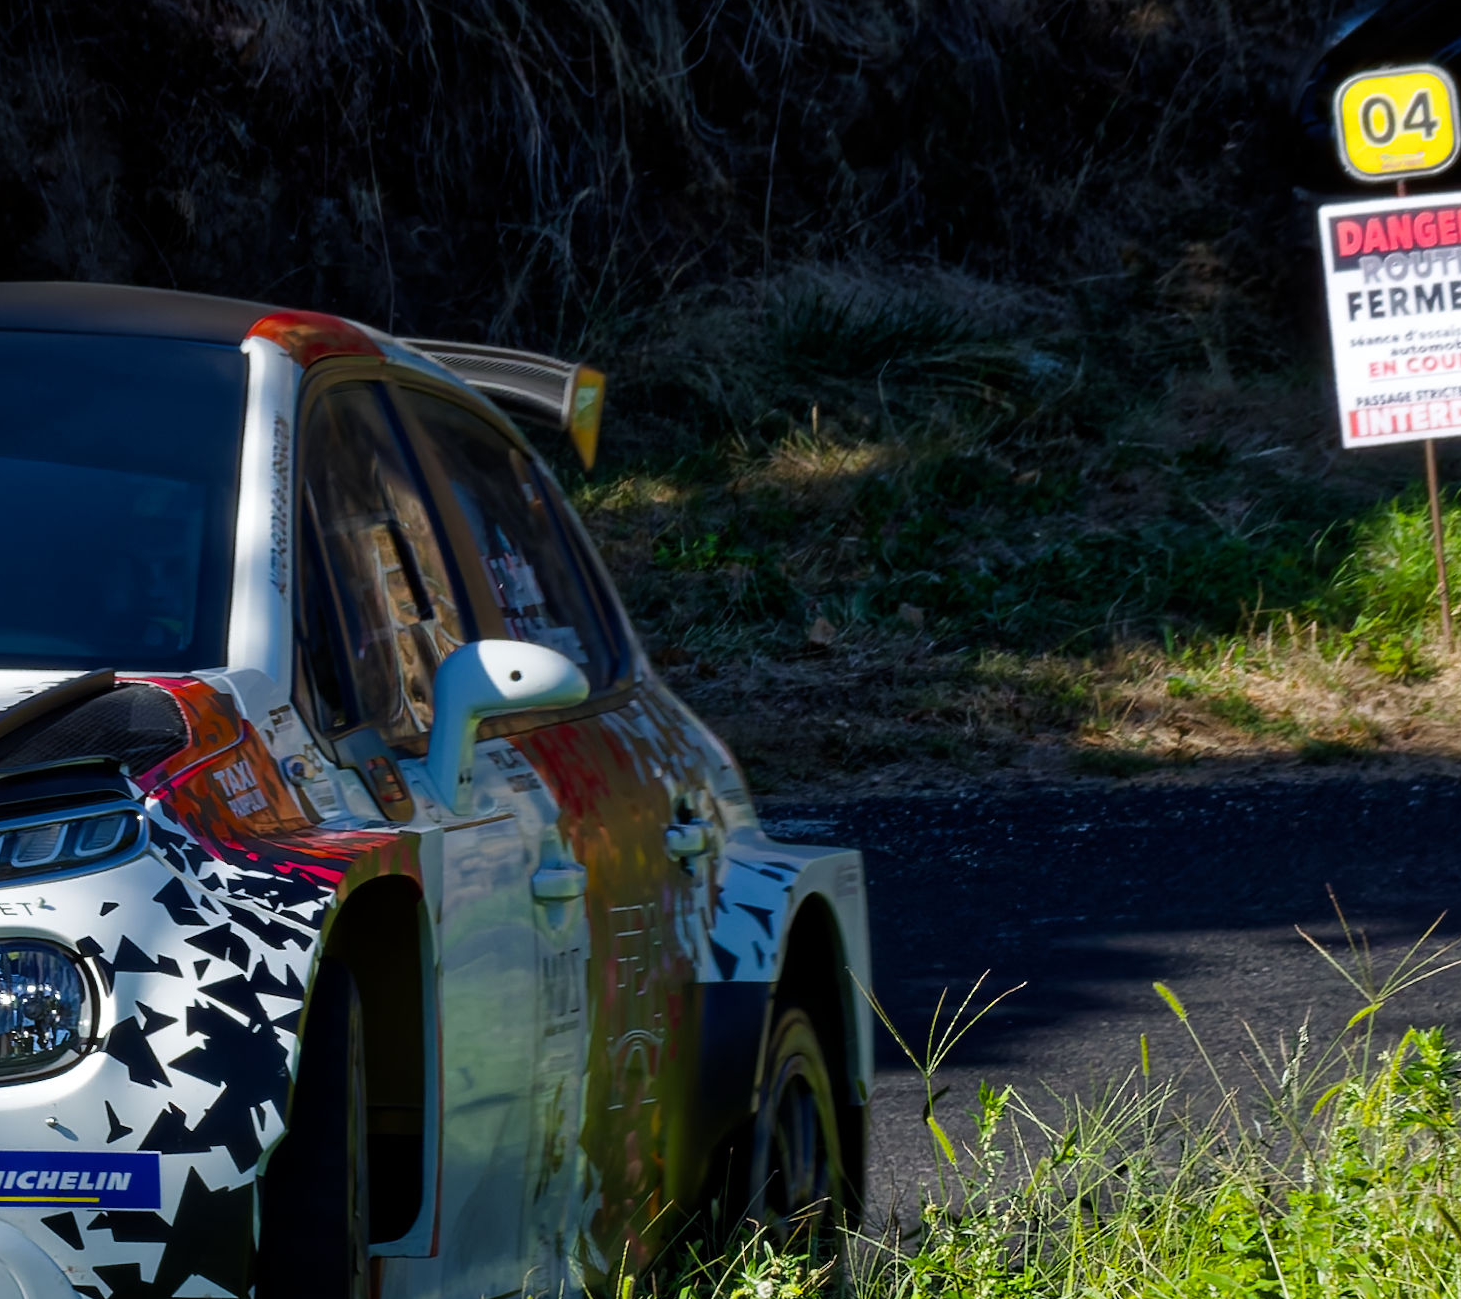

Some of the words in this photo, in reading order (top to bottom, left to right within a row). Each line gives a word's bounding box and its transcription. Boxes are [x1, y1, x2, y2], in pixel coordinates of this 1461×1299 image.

[1360, 91, 1439, 145] 04
[1368, 360, 1398, 378] EN
[1356, 390, 1412, 408] PASSAGE
[213, 760, 257, 797] TAXI
